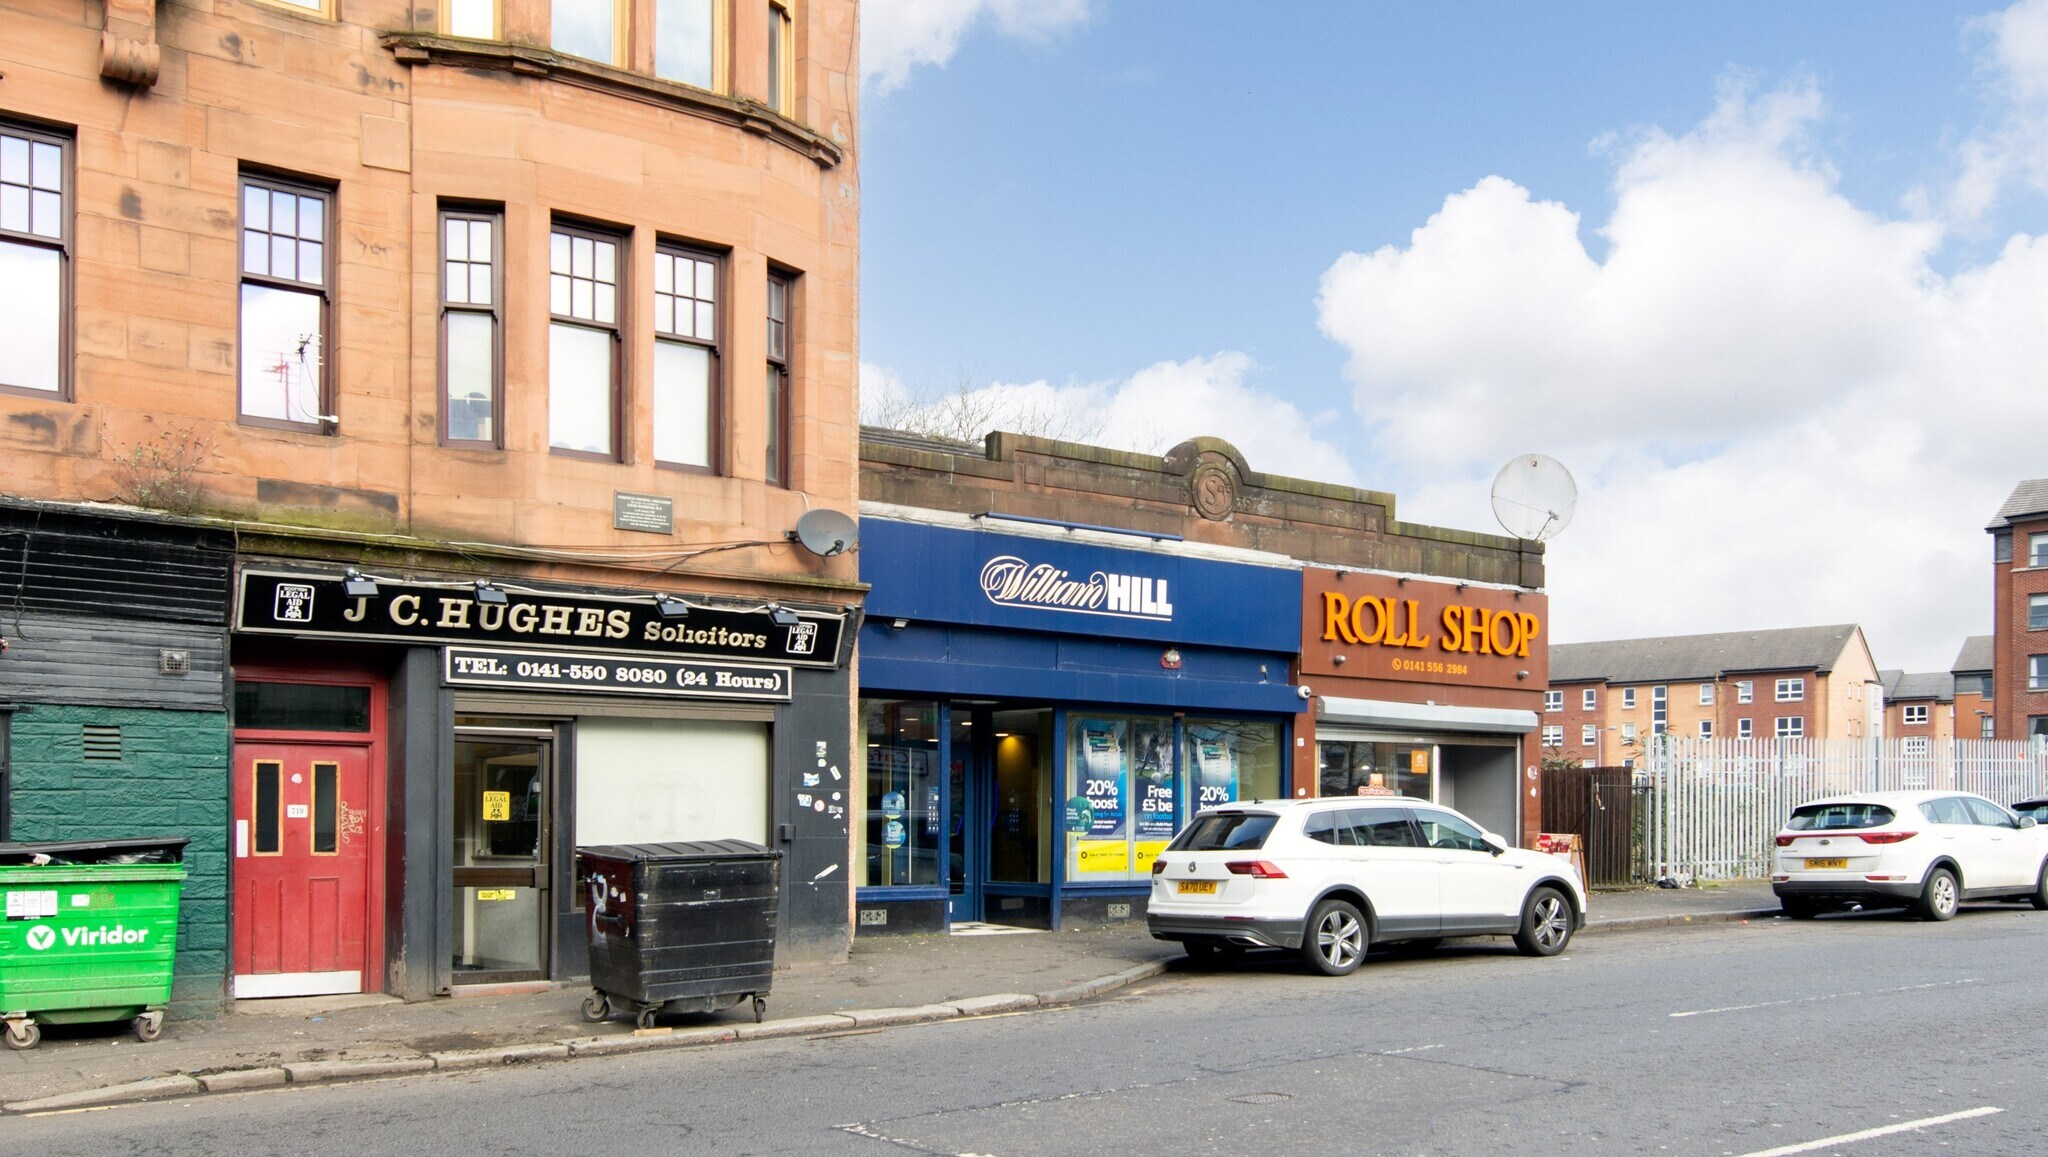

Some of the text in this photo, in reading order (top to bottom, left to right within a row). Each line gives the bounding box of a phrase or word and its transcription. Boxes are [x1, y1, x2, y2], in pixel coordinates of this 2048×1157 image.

[980, 555, 1173, 616] William HILL
[280, 590, 311, 600] LEGAL
[791, 626, 814, 635] LEGAL
[1323, 591, 1540, 657] ROLL SHOP
[643, 621, 767, 649] Solicitors
[454, 656, 782, 691] TEL: 0141-550 8080 (24 Hours)
[1403, 661, 1468, 674] 0141 556 2984
[1086, 780, 1118, 796] 20%
[1147, 785, 1173, 798] Free
[1199, 786, 1230, 802] 20%
[1142, 799, 1157, 812] £5
[1180, 881, 1214, 892] SA70 UEY
[61, 924, 149, 946] Viridor
